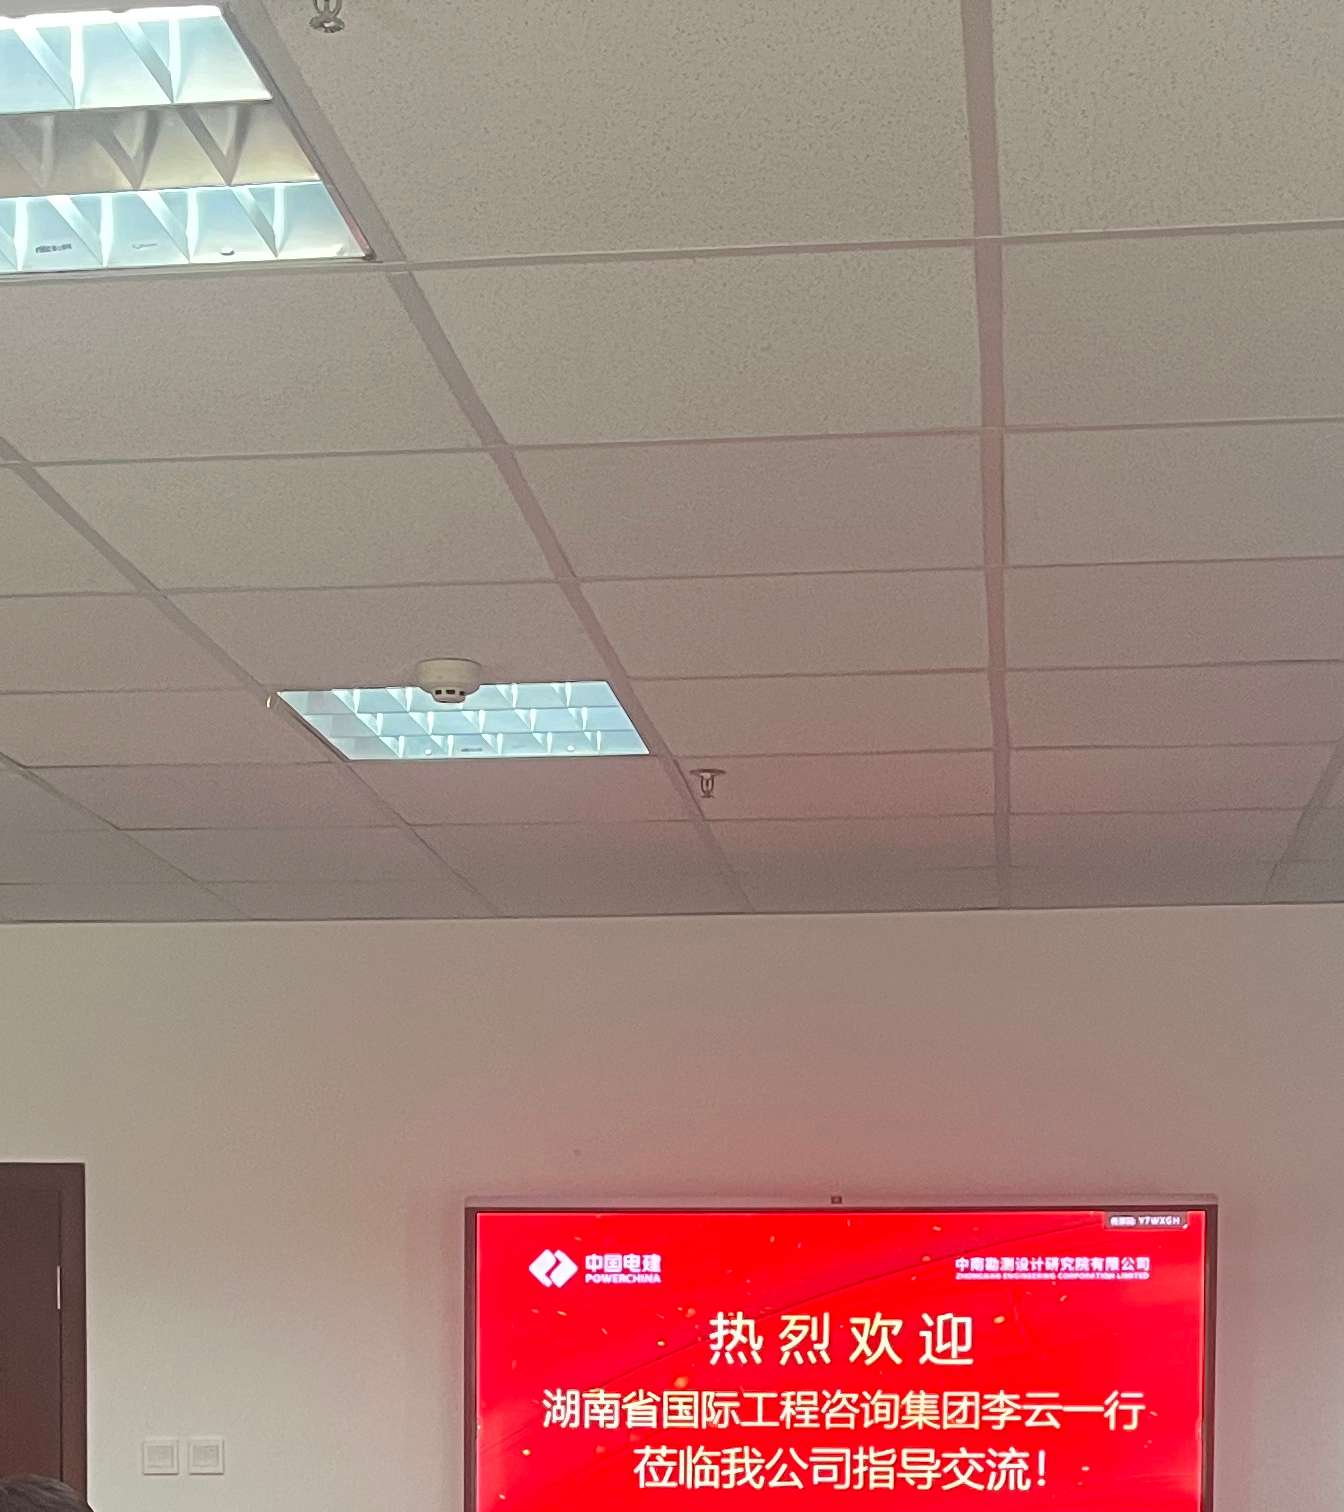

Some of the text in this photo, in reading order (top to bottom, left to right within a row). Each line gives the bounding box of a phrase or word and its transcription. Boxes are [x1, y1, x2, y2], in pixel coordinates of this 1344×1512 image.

[585, 1253, 661, 1273] 中国电建
[955, 1256, 1150, 1272] 中南勘测设计研究院有限公司
[584, 1273, 661, 1284] POWERCHINA
[709, 1311, 974, 1366] 热烈欢迎
[542, 1388, 1146, 1431] 湖南省国际工程咨询集团李云一行
